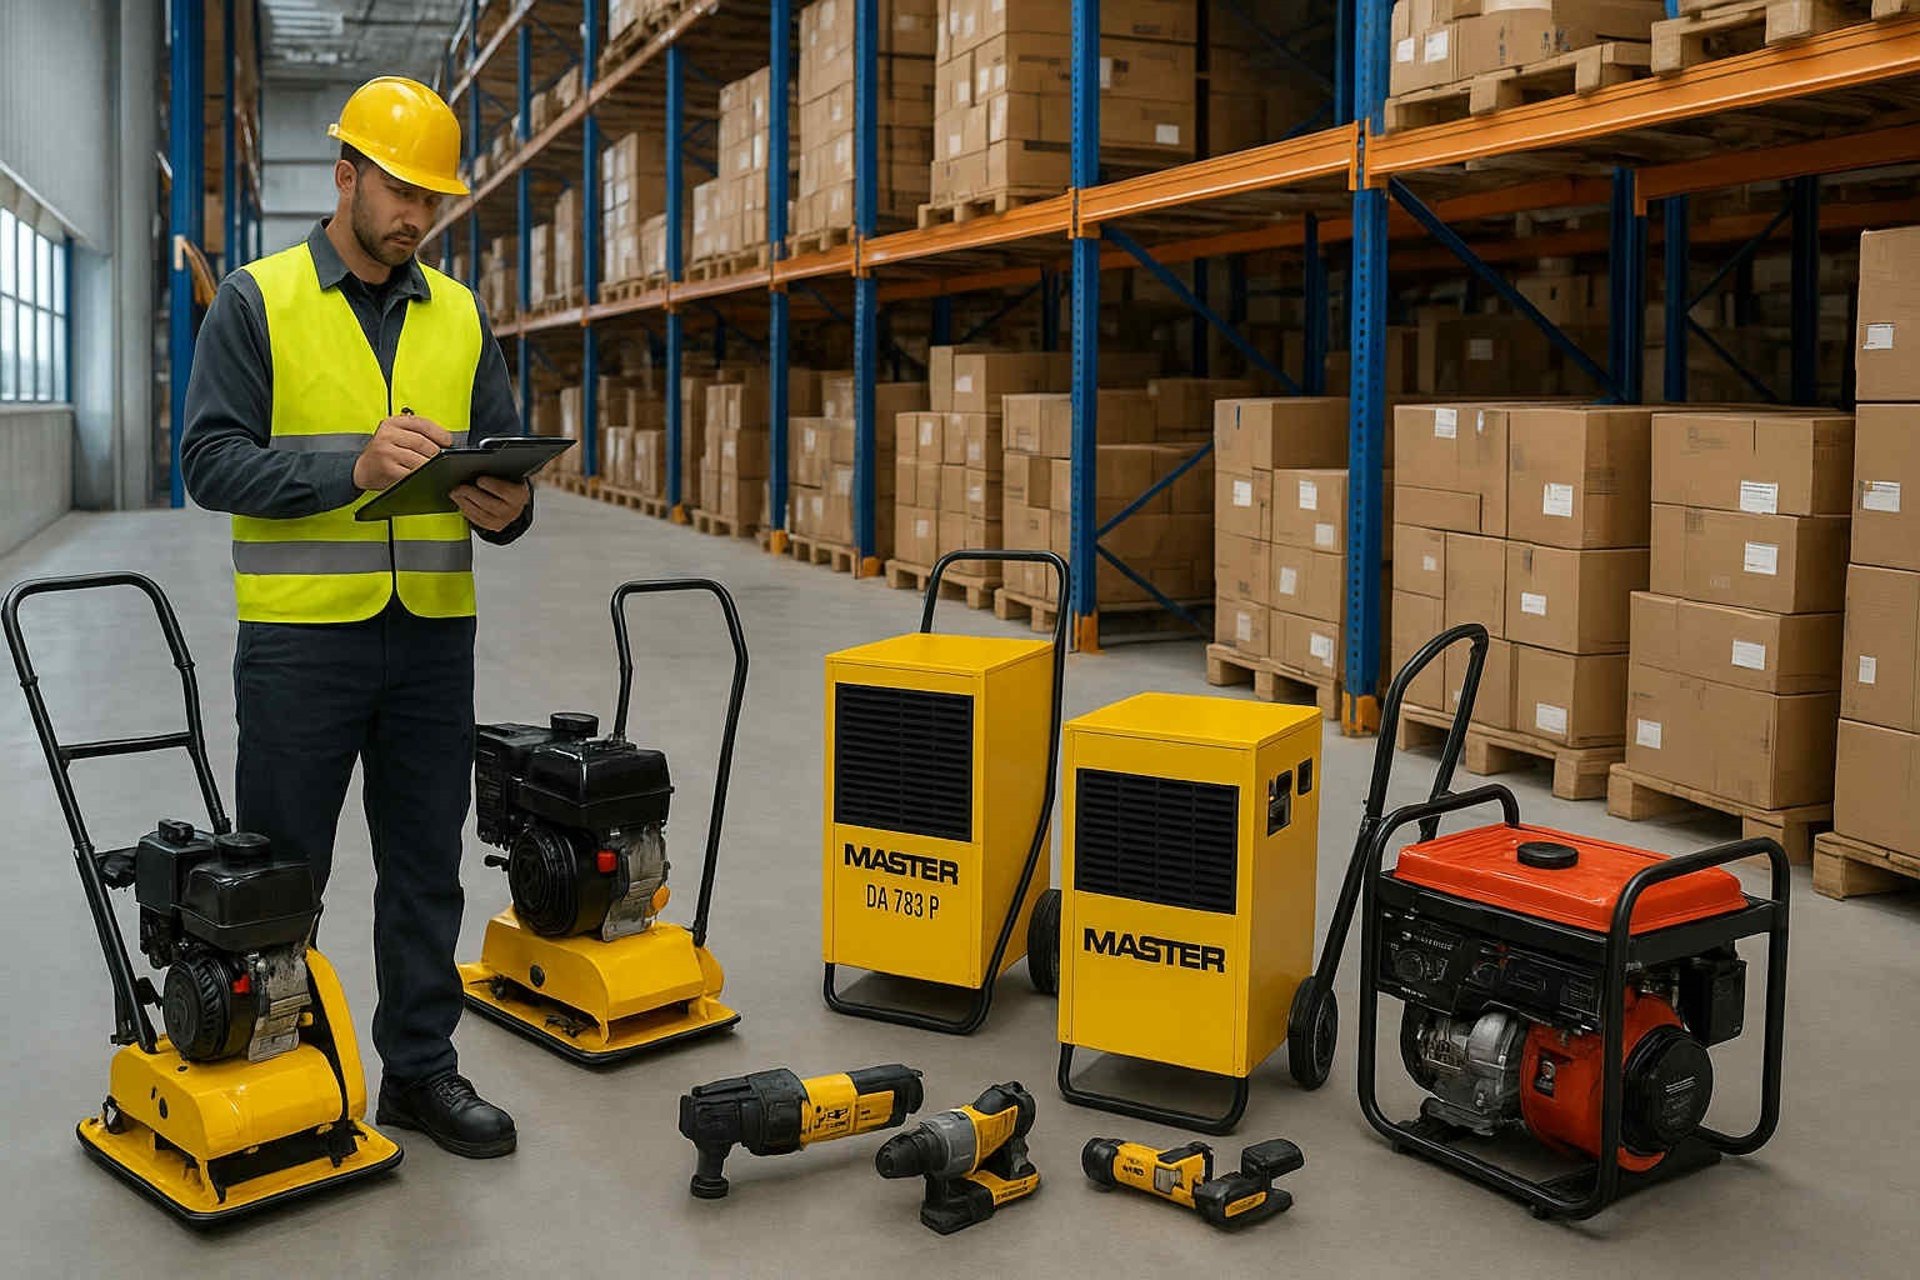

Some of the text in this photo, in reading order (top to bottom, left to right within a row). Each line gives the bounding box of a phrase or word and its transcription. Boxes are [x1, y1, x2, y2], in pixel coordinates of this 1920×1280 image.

[844, 843, 959, 886] MASTER
[866, 884, 940, 920] DA 783 P
[1083, 927, 1226, 974] MASTER
